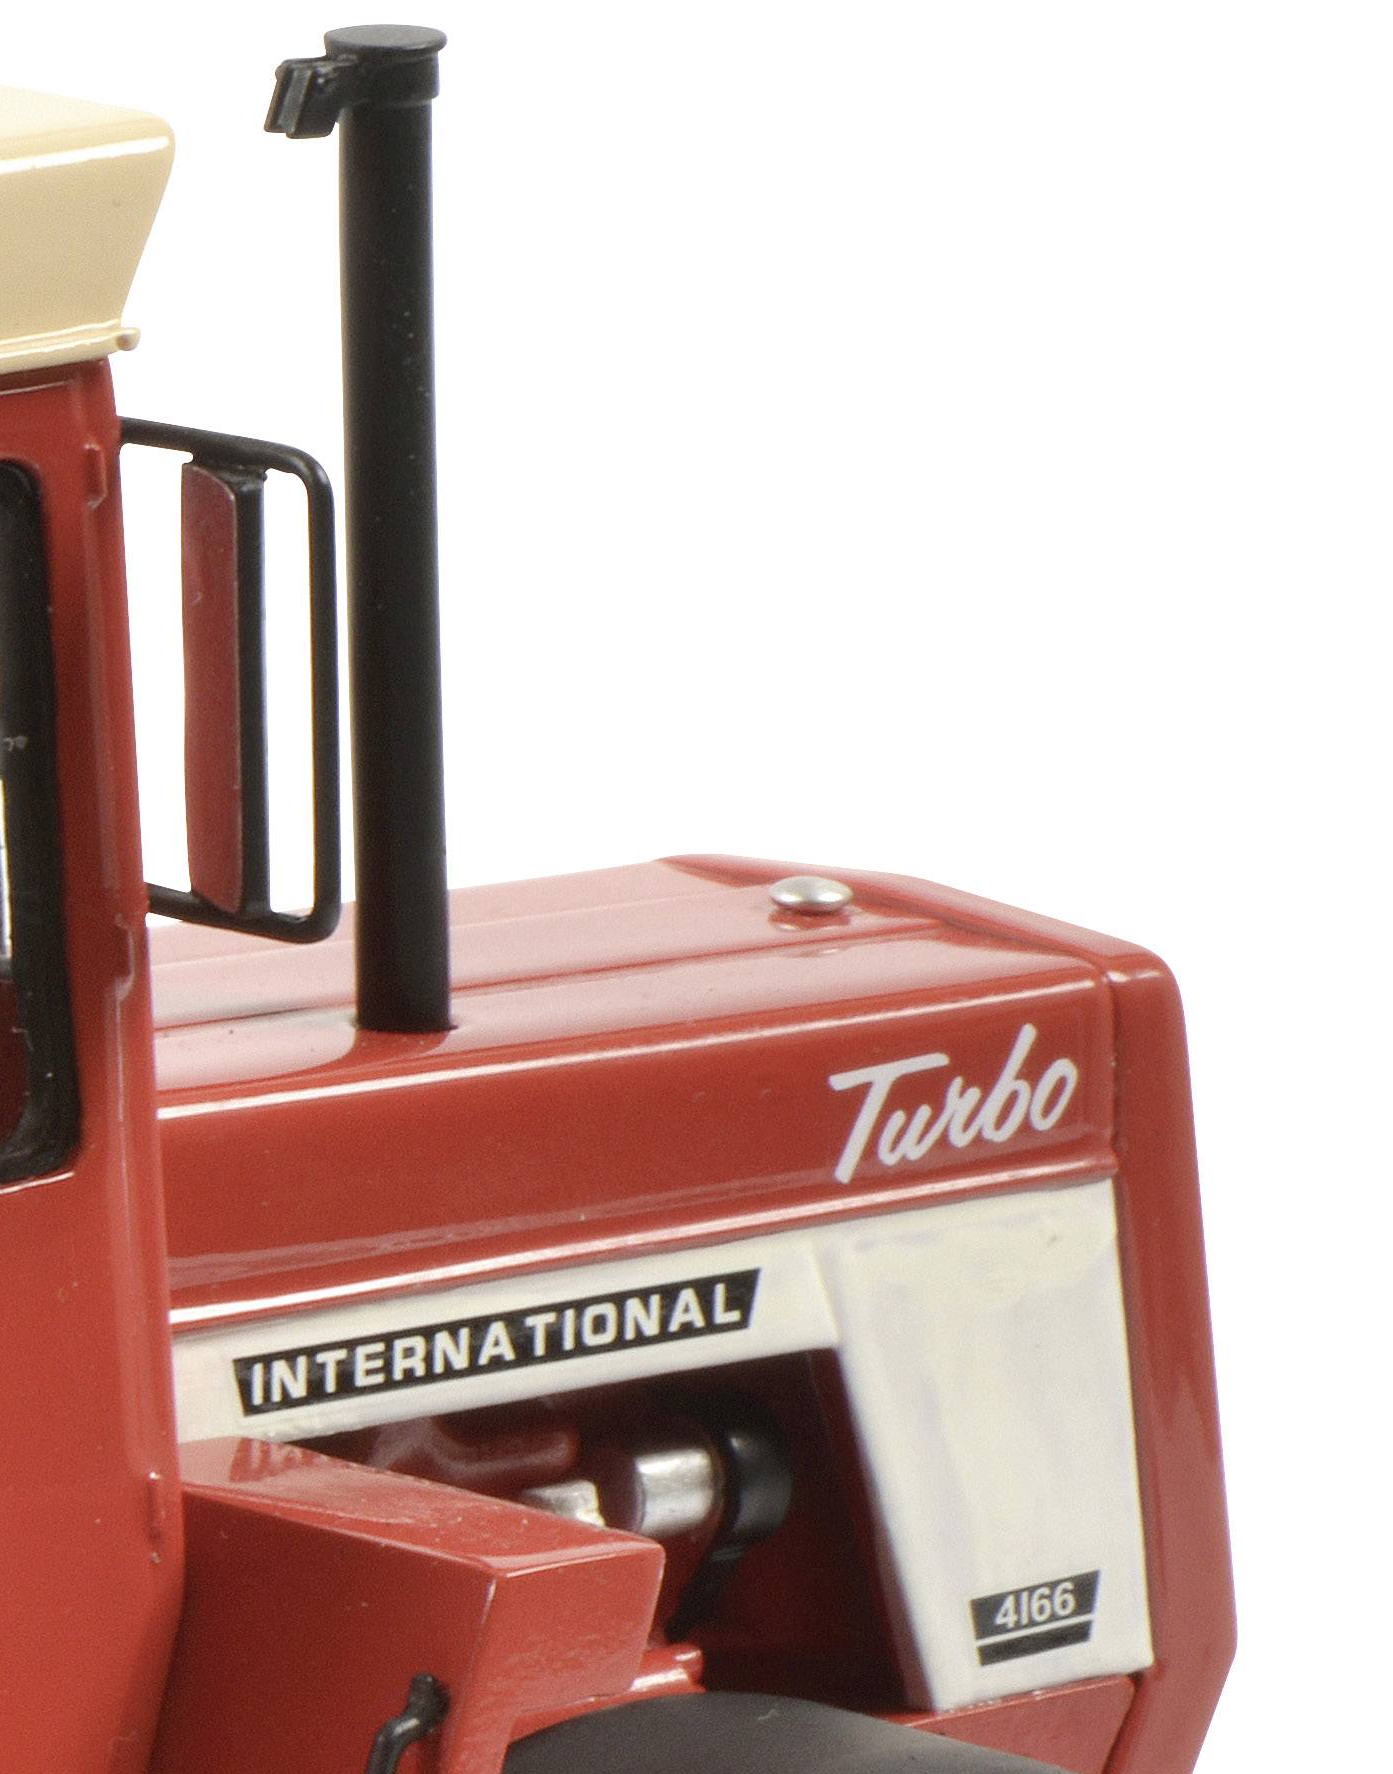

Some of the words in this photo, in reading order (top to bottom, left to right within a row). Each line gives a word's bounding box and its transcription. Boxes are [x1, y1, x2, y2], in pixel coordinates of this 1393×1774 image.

[828, 1023, 1078, 1184] Turbo
[250, 1283, 741, 1407] INTERNATIONAL
[995, 1581, 1075, 1628] 4166
